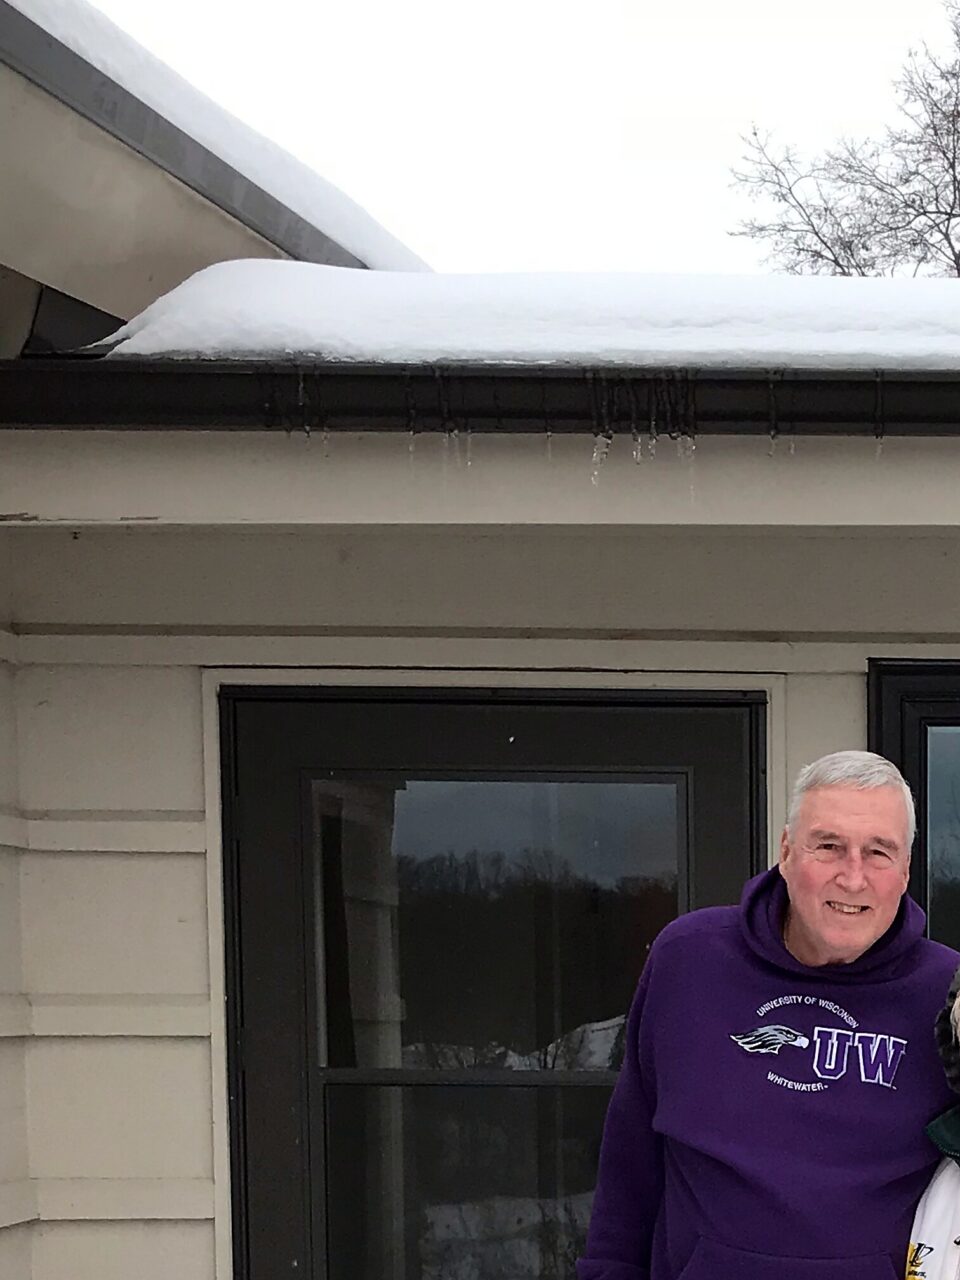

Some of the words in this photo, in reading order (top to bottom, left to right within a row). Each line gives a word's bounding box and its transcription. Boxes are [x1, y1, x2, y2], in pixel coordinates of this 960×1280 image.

[757, 995, 802, 1016] UNIVERSITY
[804, 996, 817, 1004] OF
[819, 999, 859, 1028] WISCONSIN
[813, 1026, 907, 1088] UW
[767, 1071, 823, 1092] WHITEWATER
